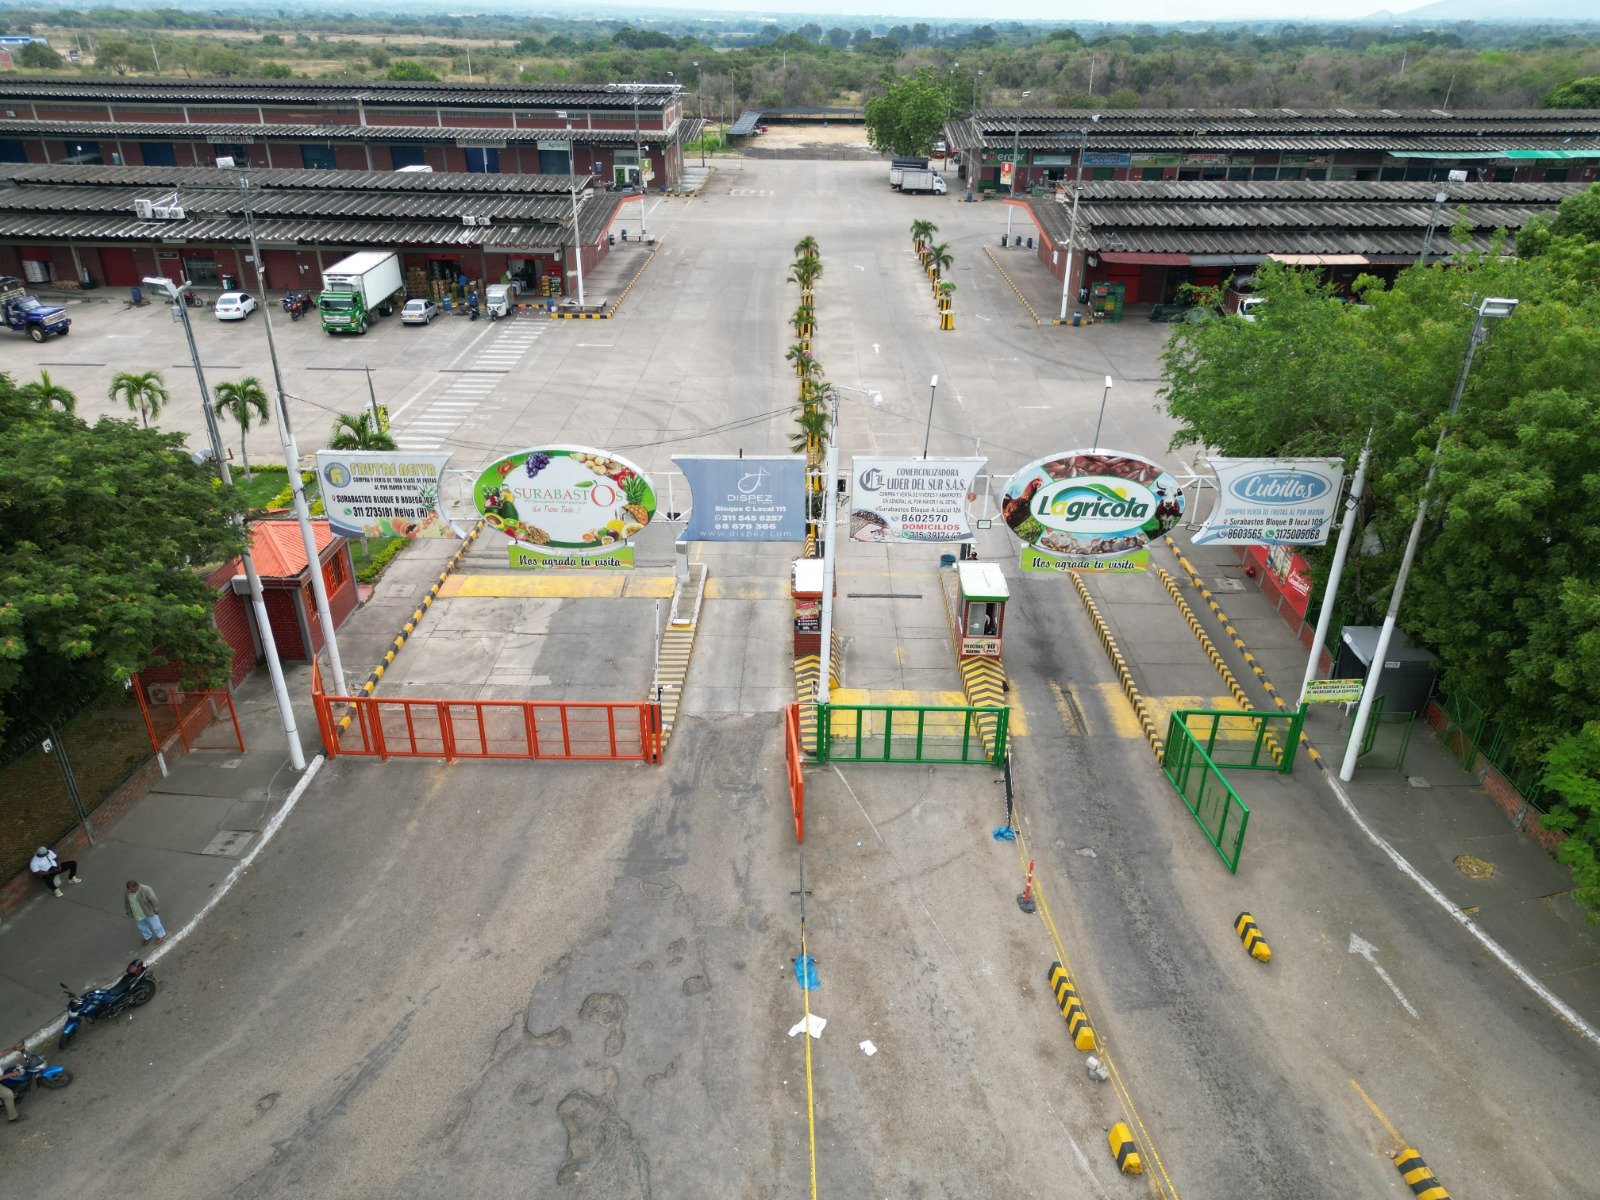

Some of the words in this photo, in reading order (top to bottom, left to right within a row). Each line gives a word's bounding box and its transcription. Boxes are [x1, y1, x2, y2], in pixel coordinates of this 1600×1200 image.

[350, 463, 396, 476] FRUTAS
[399, 463, 436, 476] NEIVA
[897, 468, 959, 476] COMERCIALIZADORA
[887, 478, 909, 490] LIDER
[912, 479, 926, 490] DEL
[928, 479, 943, 490] SUR
[946, 479, 966, 491] S.A.S.
[1245, 477, 1315, 498] Cubillos
[336, 495, 372, 503] SURABASTOS
[373, 495, 394, 503] BLOQUE
[515, 484, 622, 507] SURABASTOS
[353, 507, 364, 517] 311
[365, 507, 392, 517] 2735181
[394, 507, 415, 518] Neiva
[417, 508, 428, 518] (H)
[1266, 518, 1287, 527] Bloque
[1228, 529, 1262, 539] 8603565
[519, 555, 538, 566] Nos
[542, 557, 577, 569] agrada
[581, 557, 591, 566] tu
[595, 557, 621, 566] visita
[1032, 557, 1050, 568] Nos
[1055, 559, 1089, 570] agrada
[1094, 560, 1104, 568] tu
[1109, 559, 1135, 569] visita
